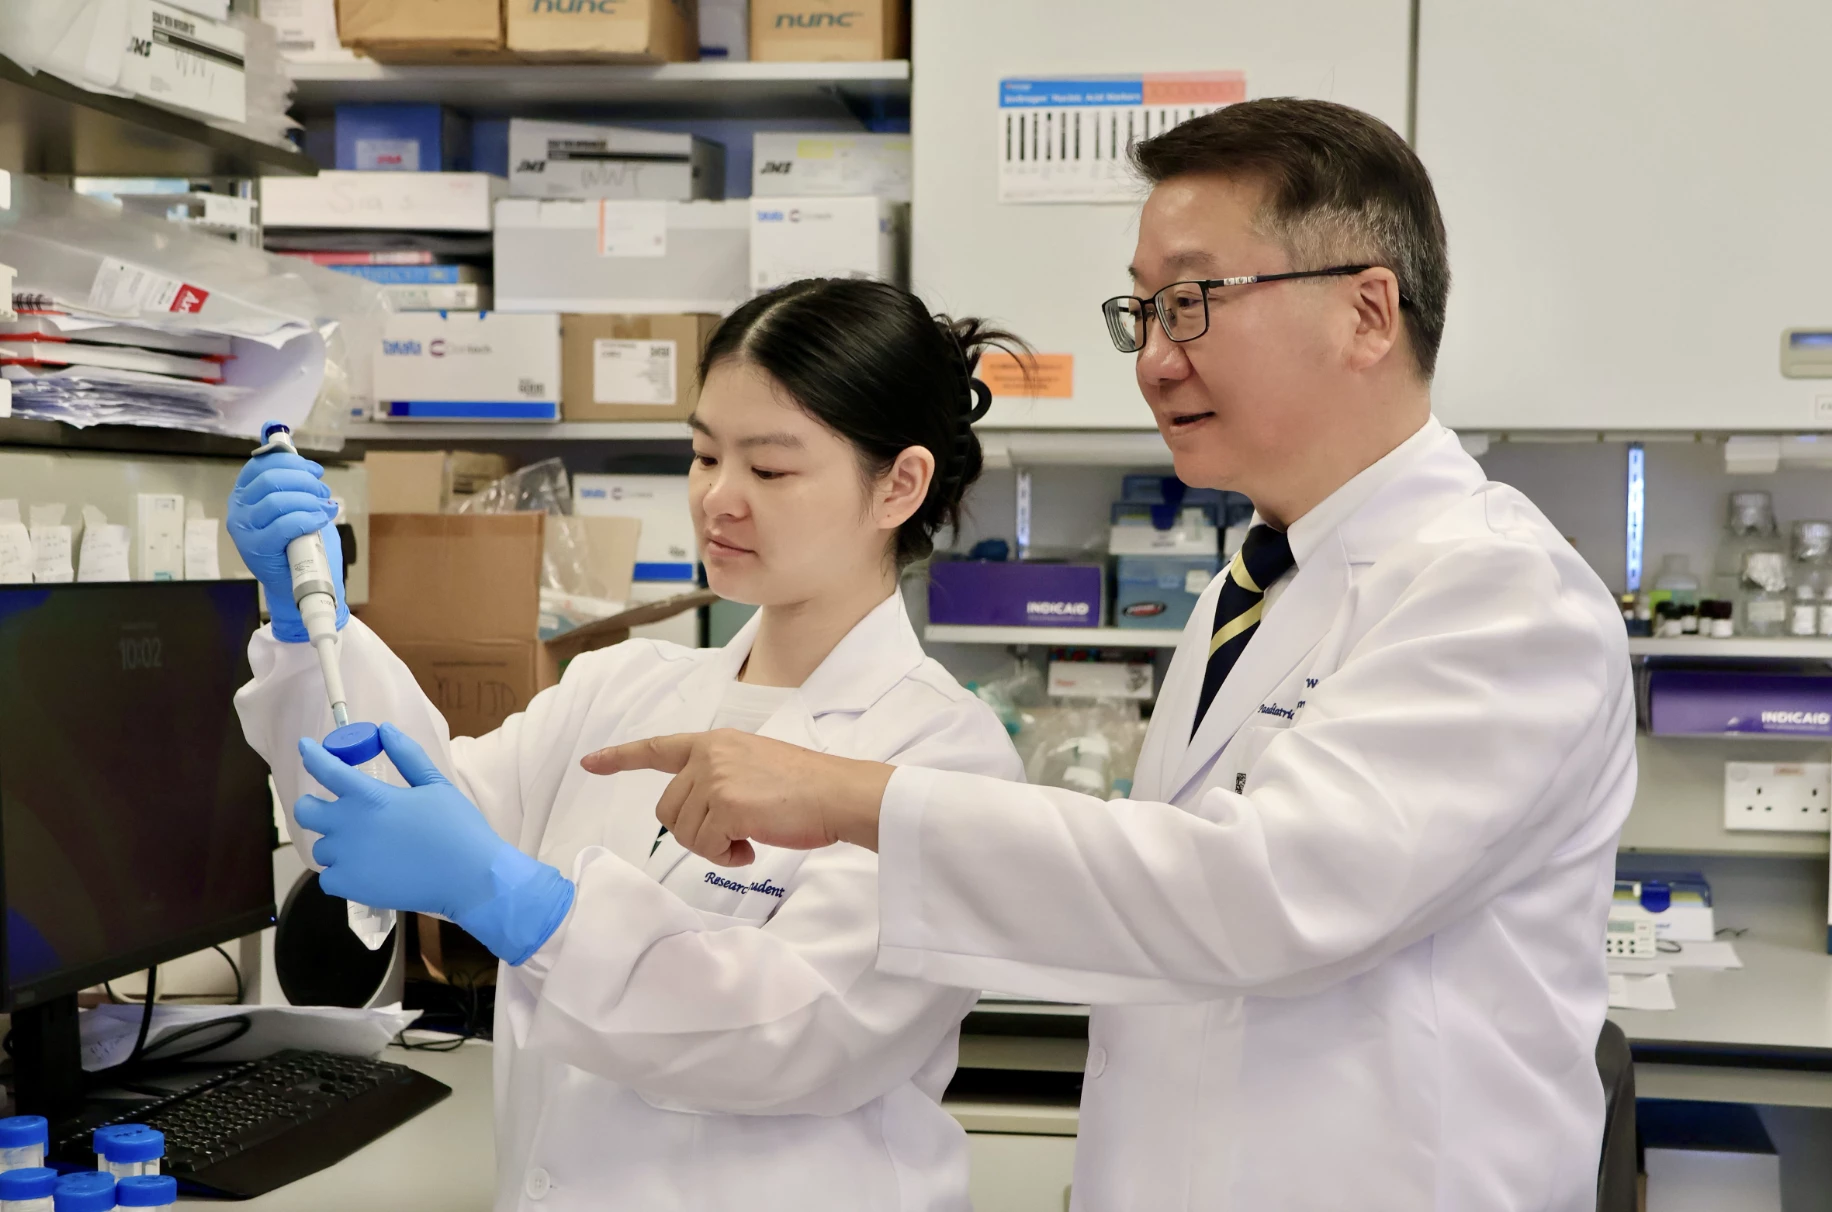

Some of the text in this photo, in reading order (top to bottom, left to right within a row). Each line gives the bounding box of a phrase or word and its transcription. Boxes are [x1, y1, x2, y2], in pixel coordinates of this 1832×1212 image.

[775, 11, 855, 29] nunc
[1026, 602, 1090, 615] INDICAID
[119, 637, 162, 671] 10:02
[1761, 711, 1831, 725] INDICAID
[704, 871, 749, 895] Researc
